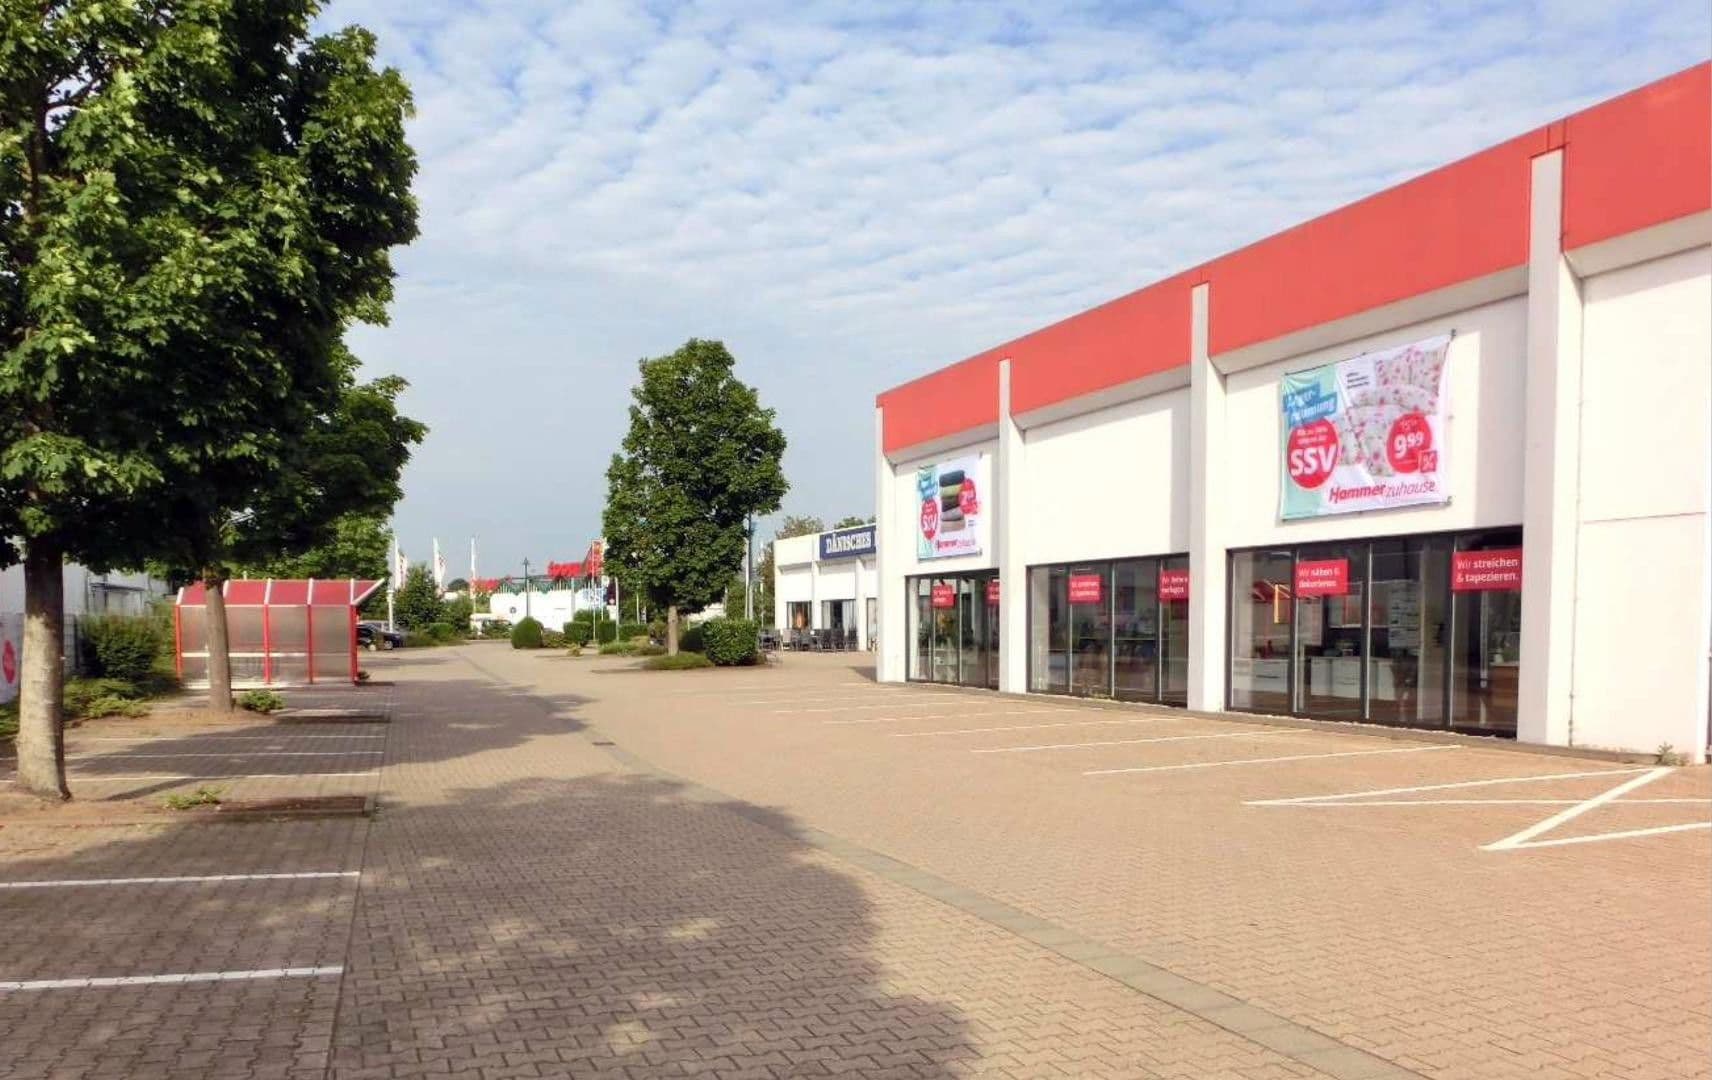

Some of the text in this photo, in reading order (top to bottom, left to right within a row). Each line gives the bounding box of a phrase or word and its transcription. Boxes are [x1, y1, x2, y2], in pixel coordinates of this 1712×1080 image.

[1290, 446, 1336, 476] SSV
[826, 533, 872, 554] DÄNISCHES
[1457, 557, 1518, 569] Wir streichen
[1456, 573, 1464, 583] &
